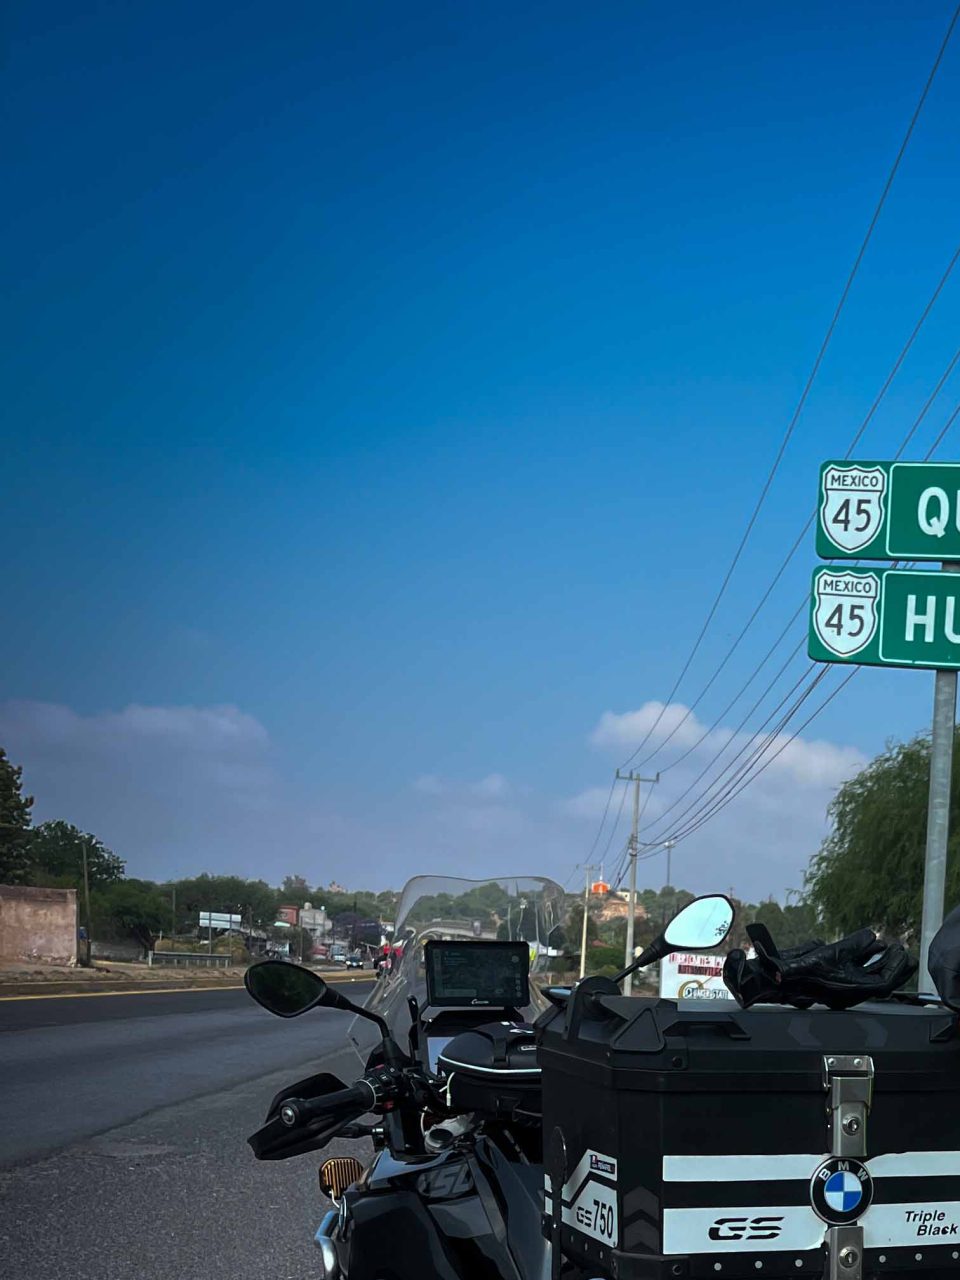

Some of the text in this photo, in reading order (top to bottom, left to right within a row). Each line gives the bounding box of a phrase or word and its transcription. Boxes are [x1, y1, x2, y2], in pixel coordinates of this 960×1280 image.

[830, 474, 879, 487] MEXICO
[832, 498, 872, 533] 45
[823, 579, 872, 594] MEXICO
[825, 603, 865, 637] 45
[818, 1161, 869, 1181] BMW
[593, 1199, 614, 1239] 750
[905, 1210, 946, 1224] Triple
[708, 1216, 785, 1241] GS
[917, 1223, 959, 1236] Black
